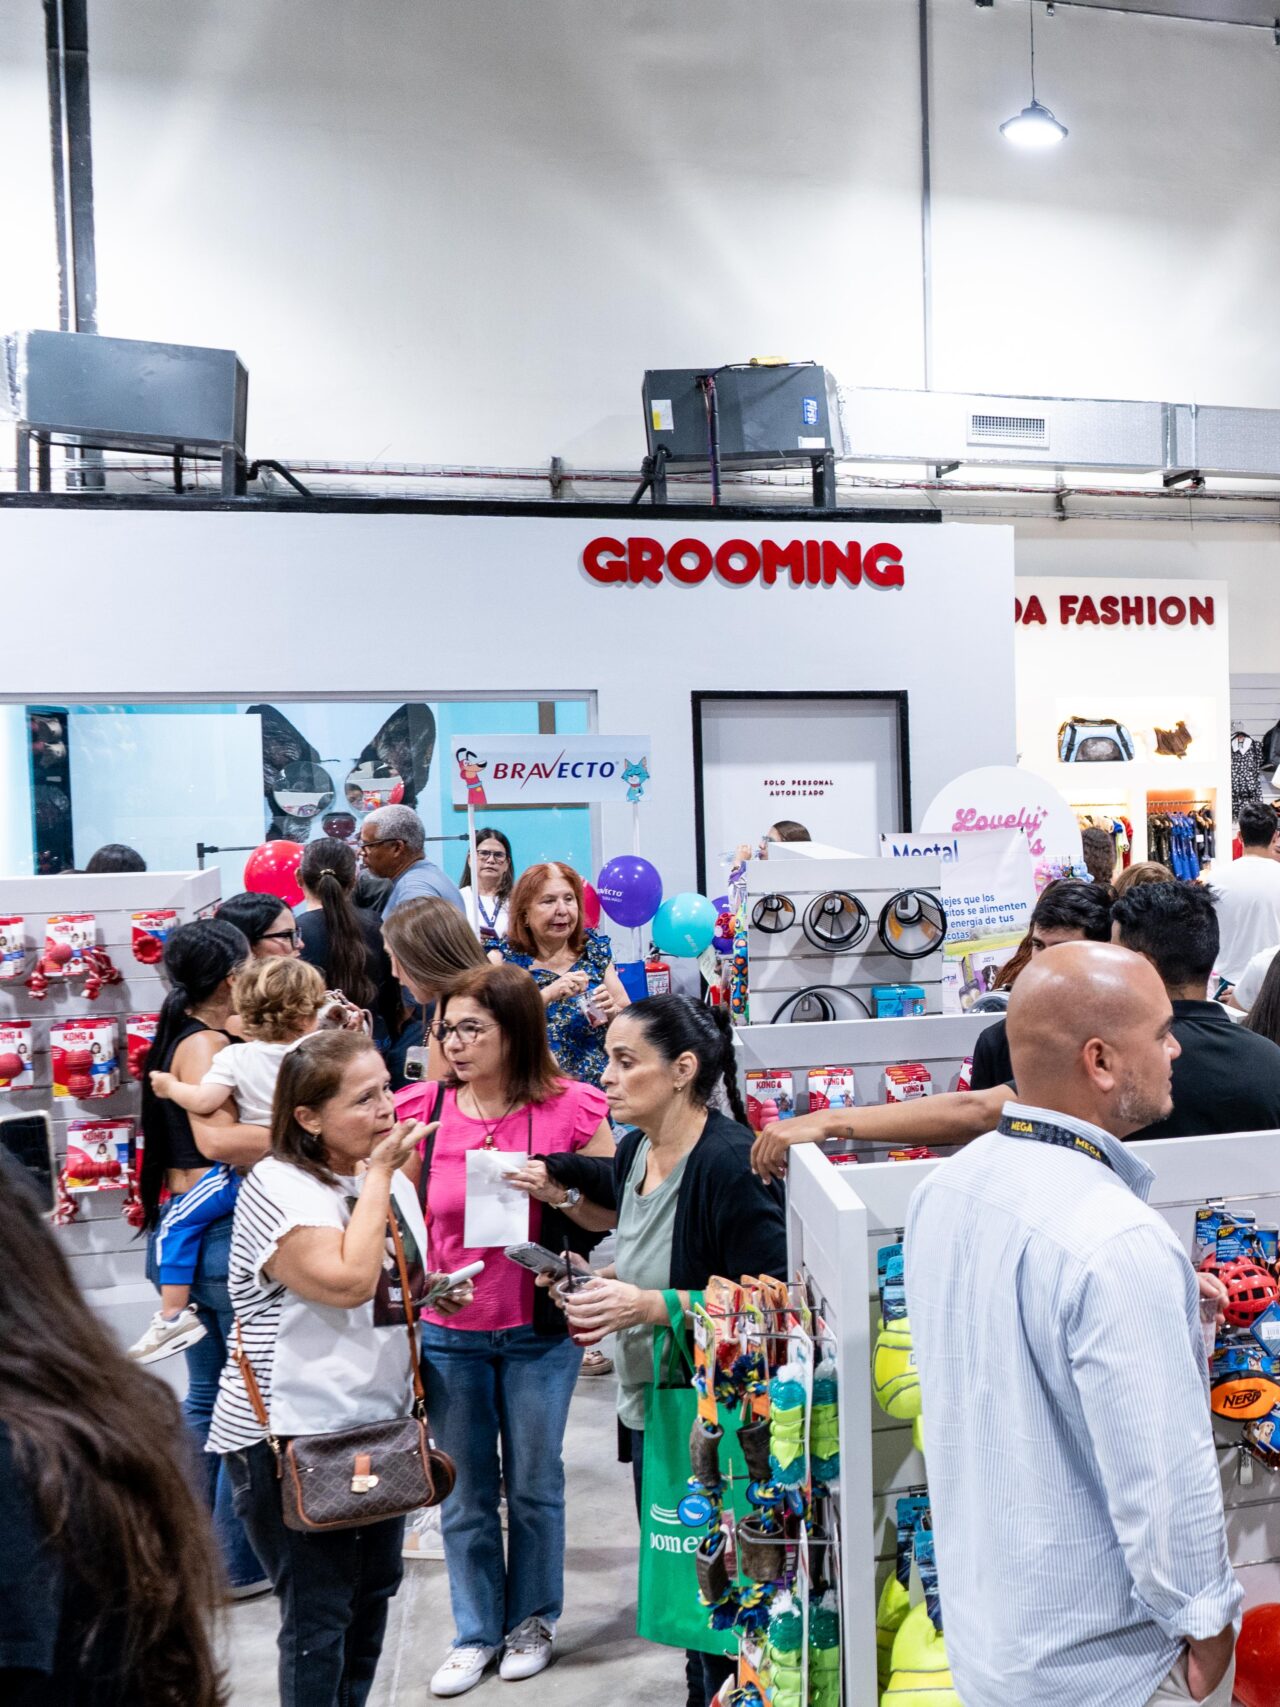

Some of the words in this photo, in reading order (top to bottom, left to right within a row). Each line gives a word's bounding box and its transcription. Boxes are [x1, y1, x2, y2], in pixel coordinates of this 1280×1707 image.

[582, 536, 905, 588] GROOMING
[1015, 597, 1047, 626] A
[1059, 595, 1216, 627] FASHION
[493, 749, 616, 789] BRAVECTO
[952, 806, 1042, 838] Lovely
[964, 897, 980, 905] que
[982, 893, 995, 902] los
[945, 908, 965, 917] sitos
[979, 902, 1027, 914] alimenten
[985, 916, 997, 925] de
[999, 915, 1015, 923] tus
[944, 931, 970, 941] scotas
[63, 1031, 87, 1041] KONG
[756, 1080, 776, 1089] KONG
[902, 1084, 920, 1093] KONG
[1010, 1121, 1033, 1133] MEGA
[82, 1131, 107, 1141] KONG
[1075, 1137, 1102, 1160] MEGA
[1223, 1390, 1262, 1409] NERF
